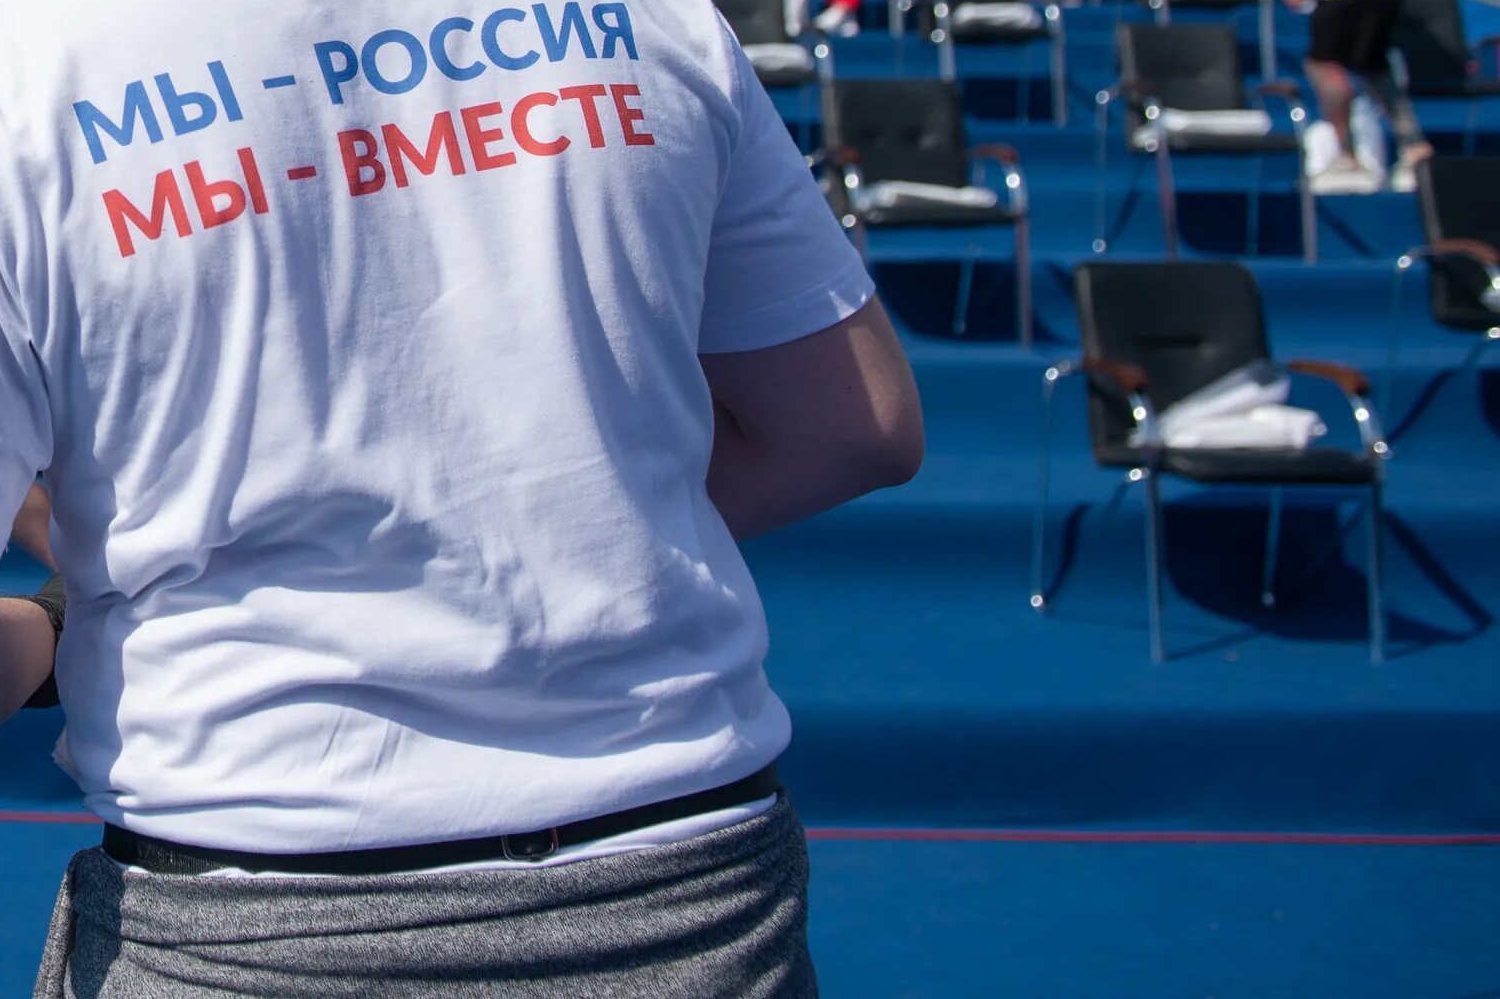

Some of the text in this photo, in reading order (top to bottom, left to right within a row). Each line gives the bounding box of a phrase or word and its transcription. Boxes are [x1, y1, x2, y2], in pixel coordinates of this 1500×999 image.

[73, 60, 244, 164] МЫ
[314, 1, 639, 105] РОССИЯ
[102, 147, 269, 258] МЫ
[337, 84, 655, 197] ВМЕСТЕ
